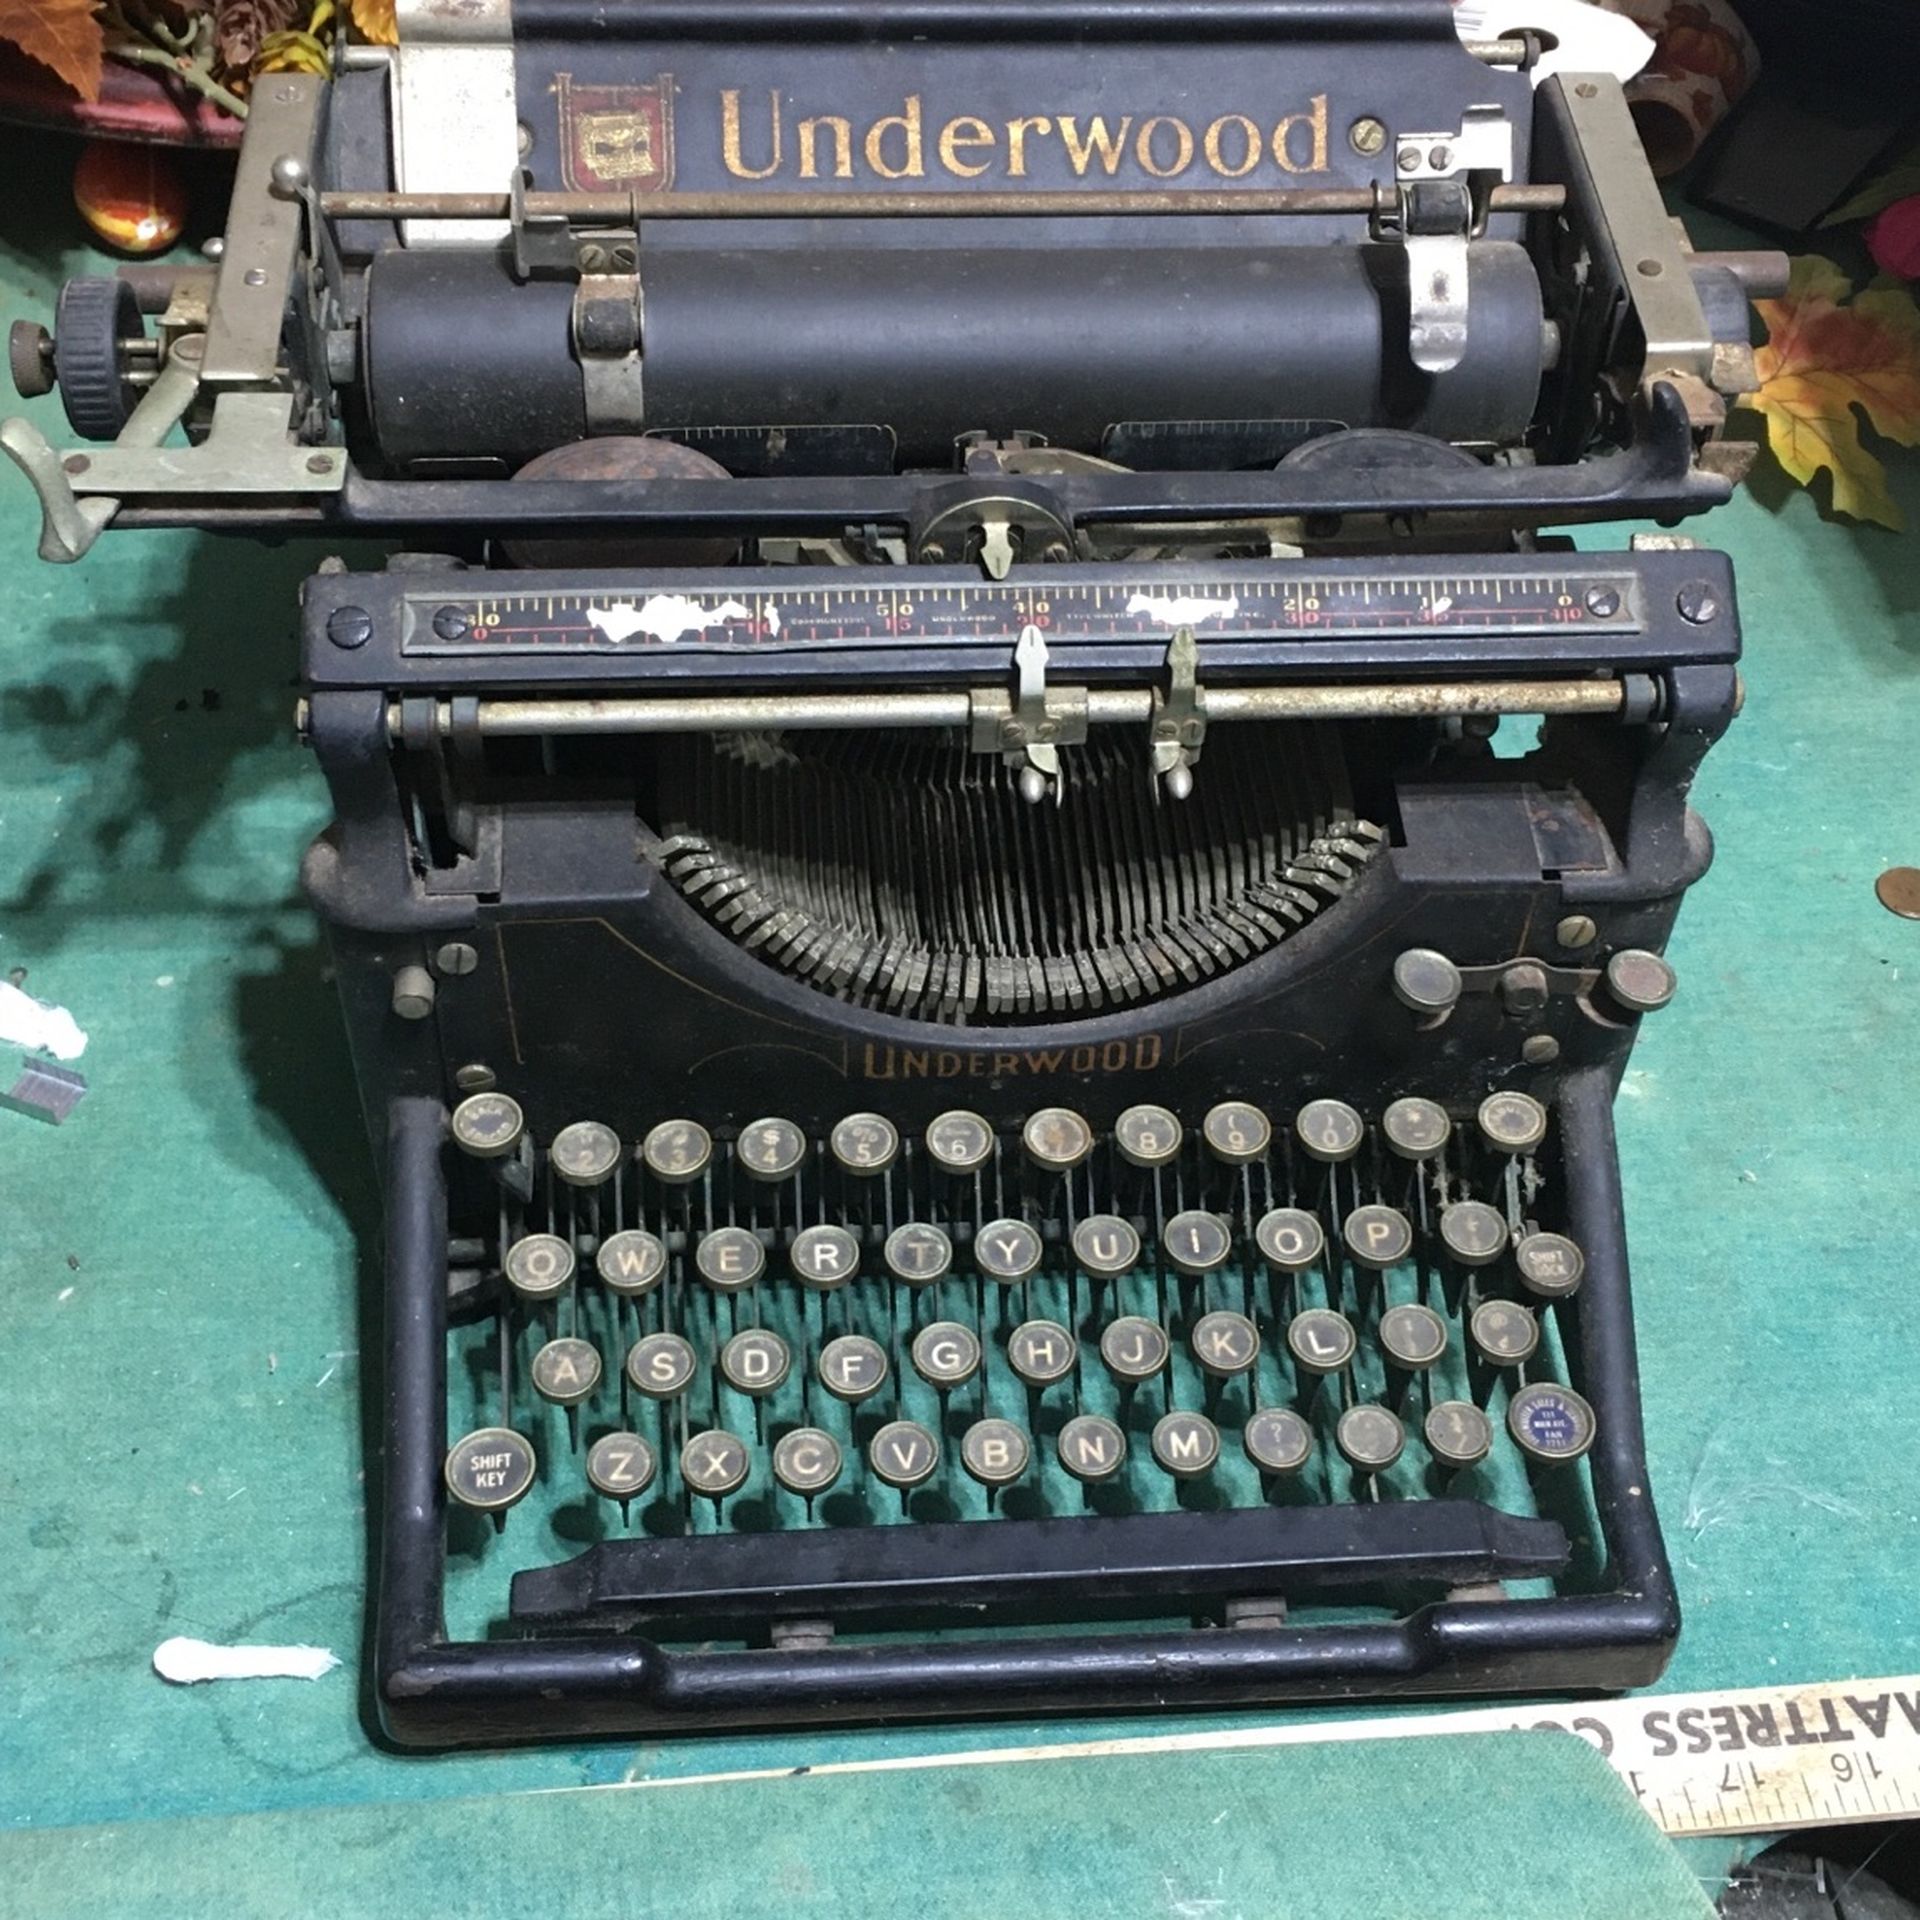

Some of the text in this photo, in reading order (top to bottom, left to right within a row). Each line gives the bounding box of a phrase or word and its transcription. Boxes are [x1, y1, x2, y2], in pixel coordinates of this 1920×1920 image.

[719, 88, 1331, 179] Underwood
[1283, 598, 1320, 611] 20
[864, 1034, 1162, 1080] UNDERWOOD
[950, 1139, 966, 1158] 6
[1139, 1132, 1156, 1151] 8
[1228, 1131, 1245, 1151] 9
[1323, 1129, 1339, 1146] 0
[762, 1150, 777, 1165] 4
[855, 1143, 871, 1162] 5
[1093, 1234, 1118, 1260] U
[1190, 1228, 1200, 1253] I
[1275, 1228, 1301, 1254] O
[1366, 1222, 1389, 1248] P
[616, 1249, 647, 1276] W
[719, 1245, 743, 1272] E
[813, 1243, 839, 1270] R
[907, 1242, 929, 1268] T
[996, 1239, 1020, 1265] Y
[1027, 1340, 1054, 1366] H
[1121, 1335, 1144, 1362] J
[1211, 1331, 1238, 1357] K
[1307, 1329, 1336, 1354] L
[650, 1352, 676, 1381] S
[743, 1349, 769, 1377] D
[931, 1341, 960, 1370] G
[553, 1355, 578, 1384] A
[842, 1356, 863, 1382] F
[892, 1442, 917, 1470] V
[983, 1439, 1009, 1467] B
[1077, 1436, 1104, 1464] N
[1169, 1430, 1200, 1459] M
[470, 1452, 512, 1471] SHIFT
[608, 1452, 633, 1481] Z
[703, 1450, 729, 1478] X
[793, 1447, 821, 1475] C
[476, 1471, 506, 1488] KEY
[1720, 1761, 1765, 1792] 17
[1831, 1750, 1883, 1783] 16
